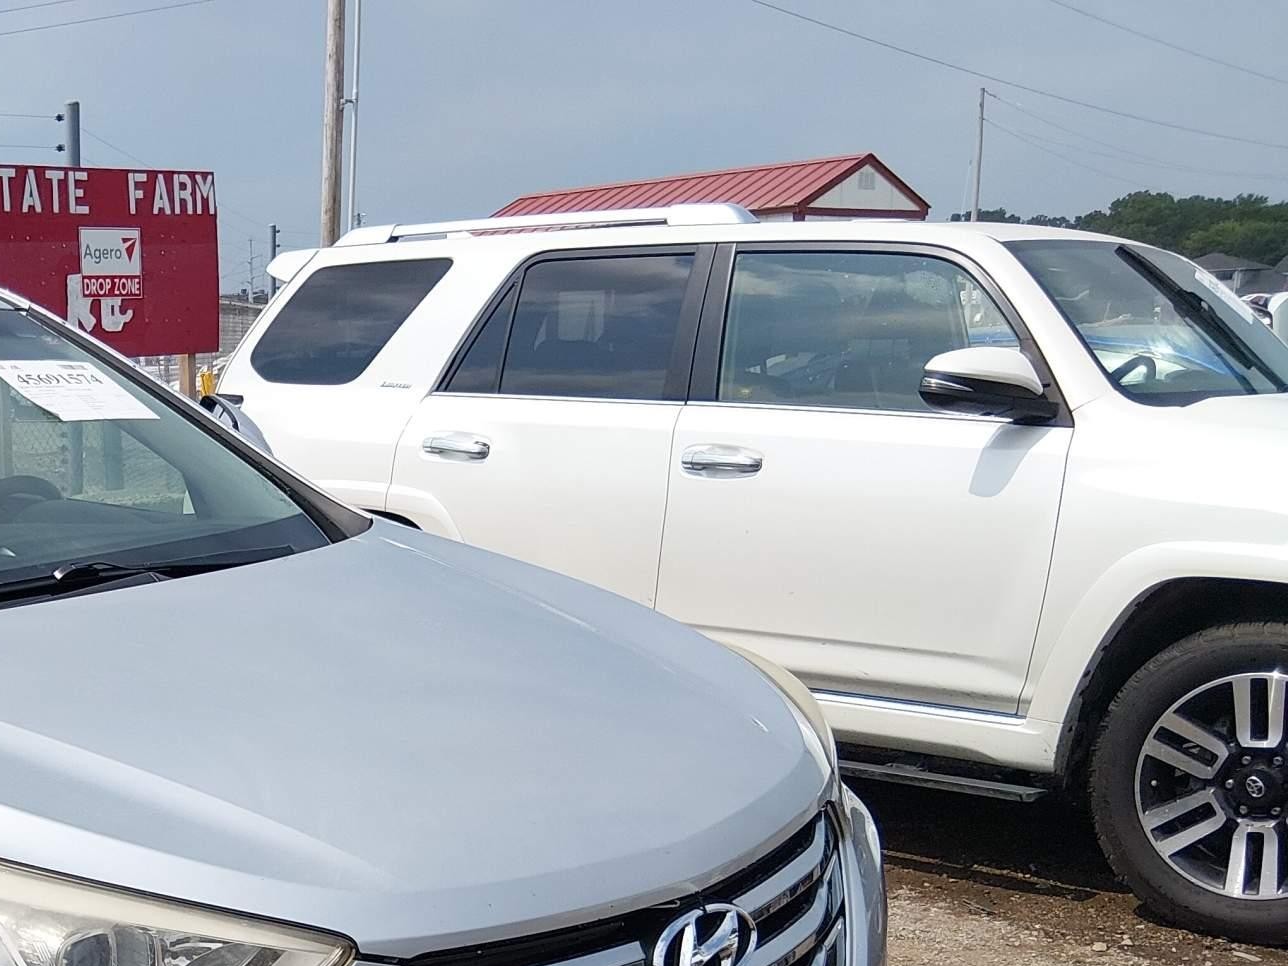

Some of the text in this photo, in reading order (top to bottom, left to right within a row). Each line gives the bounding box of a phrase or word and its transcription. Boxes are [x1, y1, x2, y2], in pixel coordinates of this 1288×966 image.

[128, 172, 216, 215] FARM
[83, 244, 122, 264] Agero
[84, 278, 140, 294] DROP ZONE
[16, 373, 104, 385] 45691574
